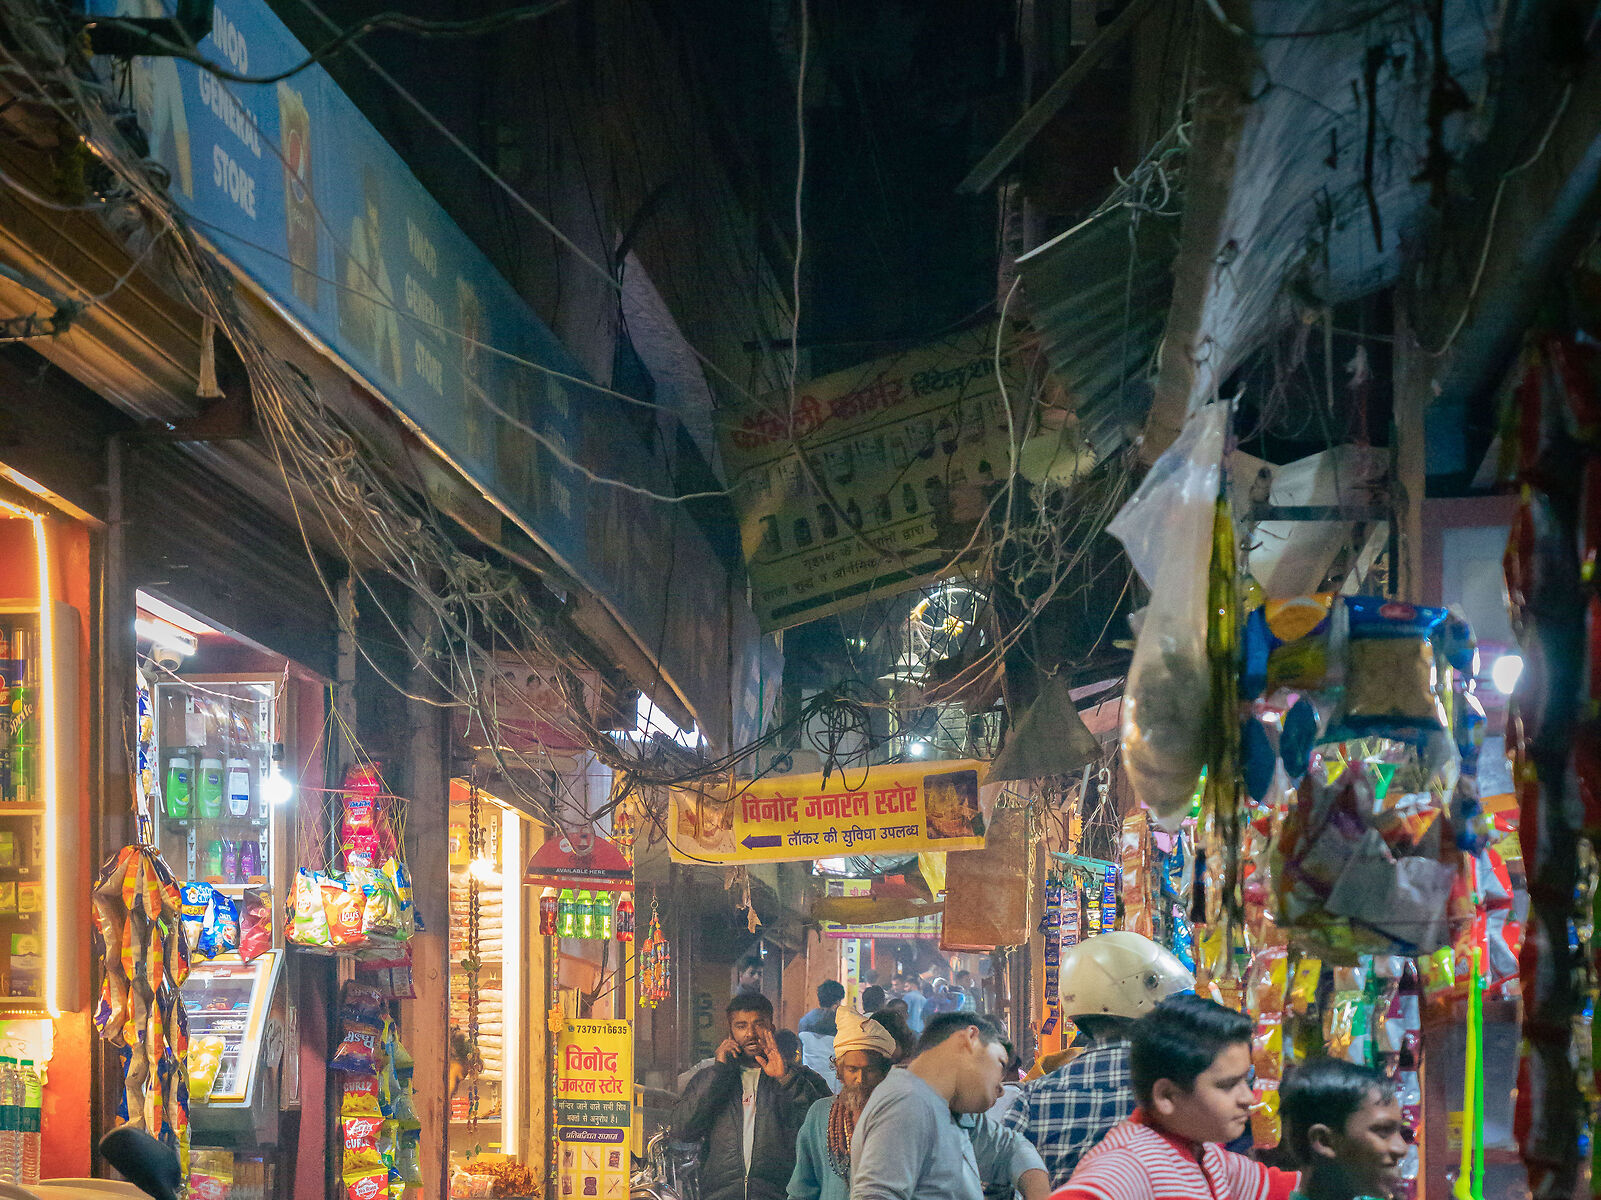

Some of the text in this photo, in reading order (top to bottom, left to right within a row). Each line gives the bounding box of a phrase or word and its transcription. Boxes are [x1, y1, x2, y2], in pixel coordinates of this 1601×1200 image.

[213, 4, 248, 75] INOD
[199, 67, 262, 160] GENERAL
[213, 143, 256, 221] STORE
[741, 781, 918, 824] विनोद जनरल स्टोर
[788, 824, 919, 848] लॉकर की सुविधा उपलब्ध
[341, 911, 359, 922] Lay's
[577, 1025, 627, 1034] 7379716635
[566, 1044, 618, 1073] विनोद
[343, 1081, 373, 1092] CURLZ
[559, 1075, 623, 1094] जनरल स्टोर
[576, 1101, 587, 1110] जाने
[589, 1102, 600, 1110] वाले
[582, 1113, 588, 1122] से
